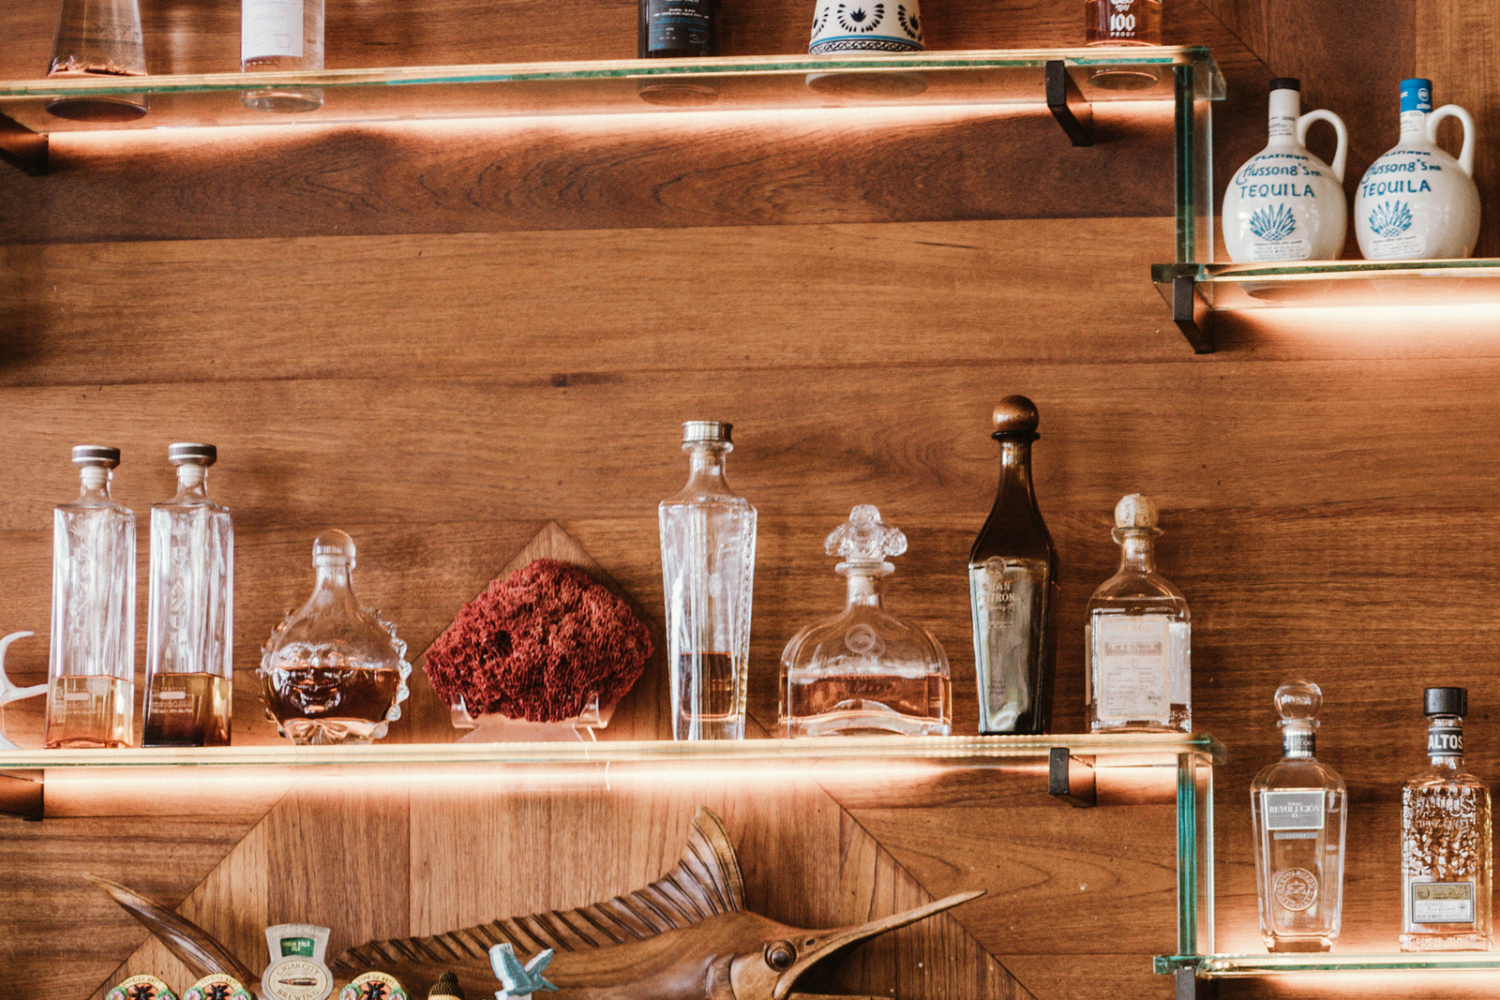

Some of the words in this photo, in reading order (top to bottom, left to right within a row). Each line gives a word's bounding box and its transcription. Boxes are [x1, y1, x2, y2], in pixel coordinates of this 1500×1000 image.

[1110, 13, 1136, 32] 100
[1240, 184, 1315, 198] TEQUILA
[1362, 180, 1432, 198] TEQUILA
[1428, 734, 1463, 750] ALTOS
[1269, 804, 1322, 814] REVOLUCIÓN
[277, 963, 300, 976] CIGAR
[302, 964, 320, 975] CITY
[277, 988, 320, 1000] BREWING
